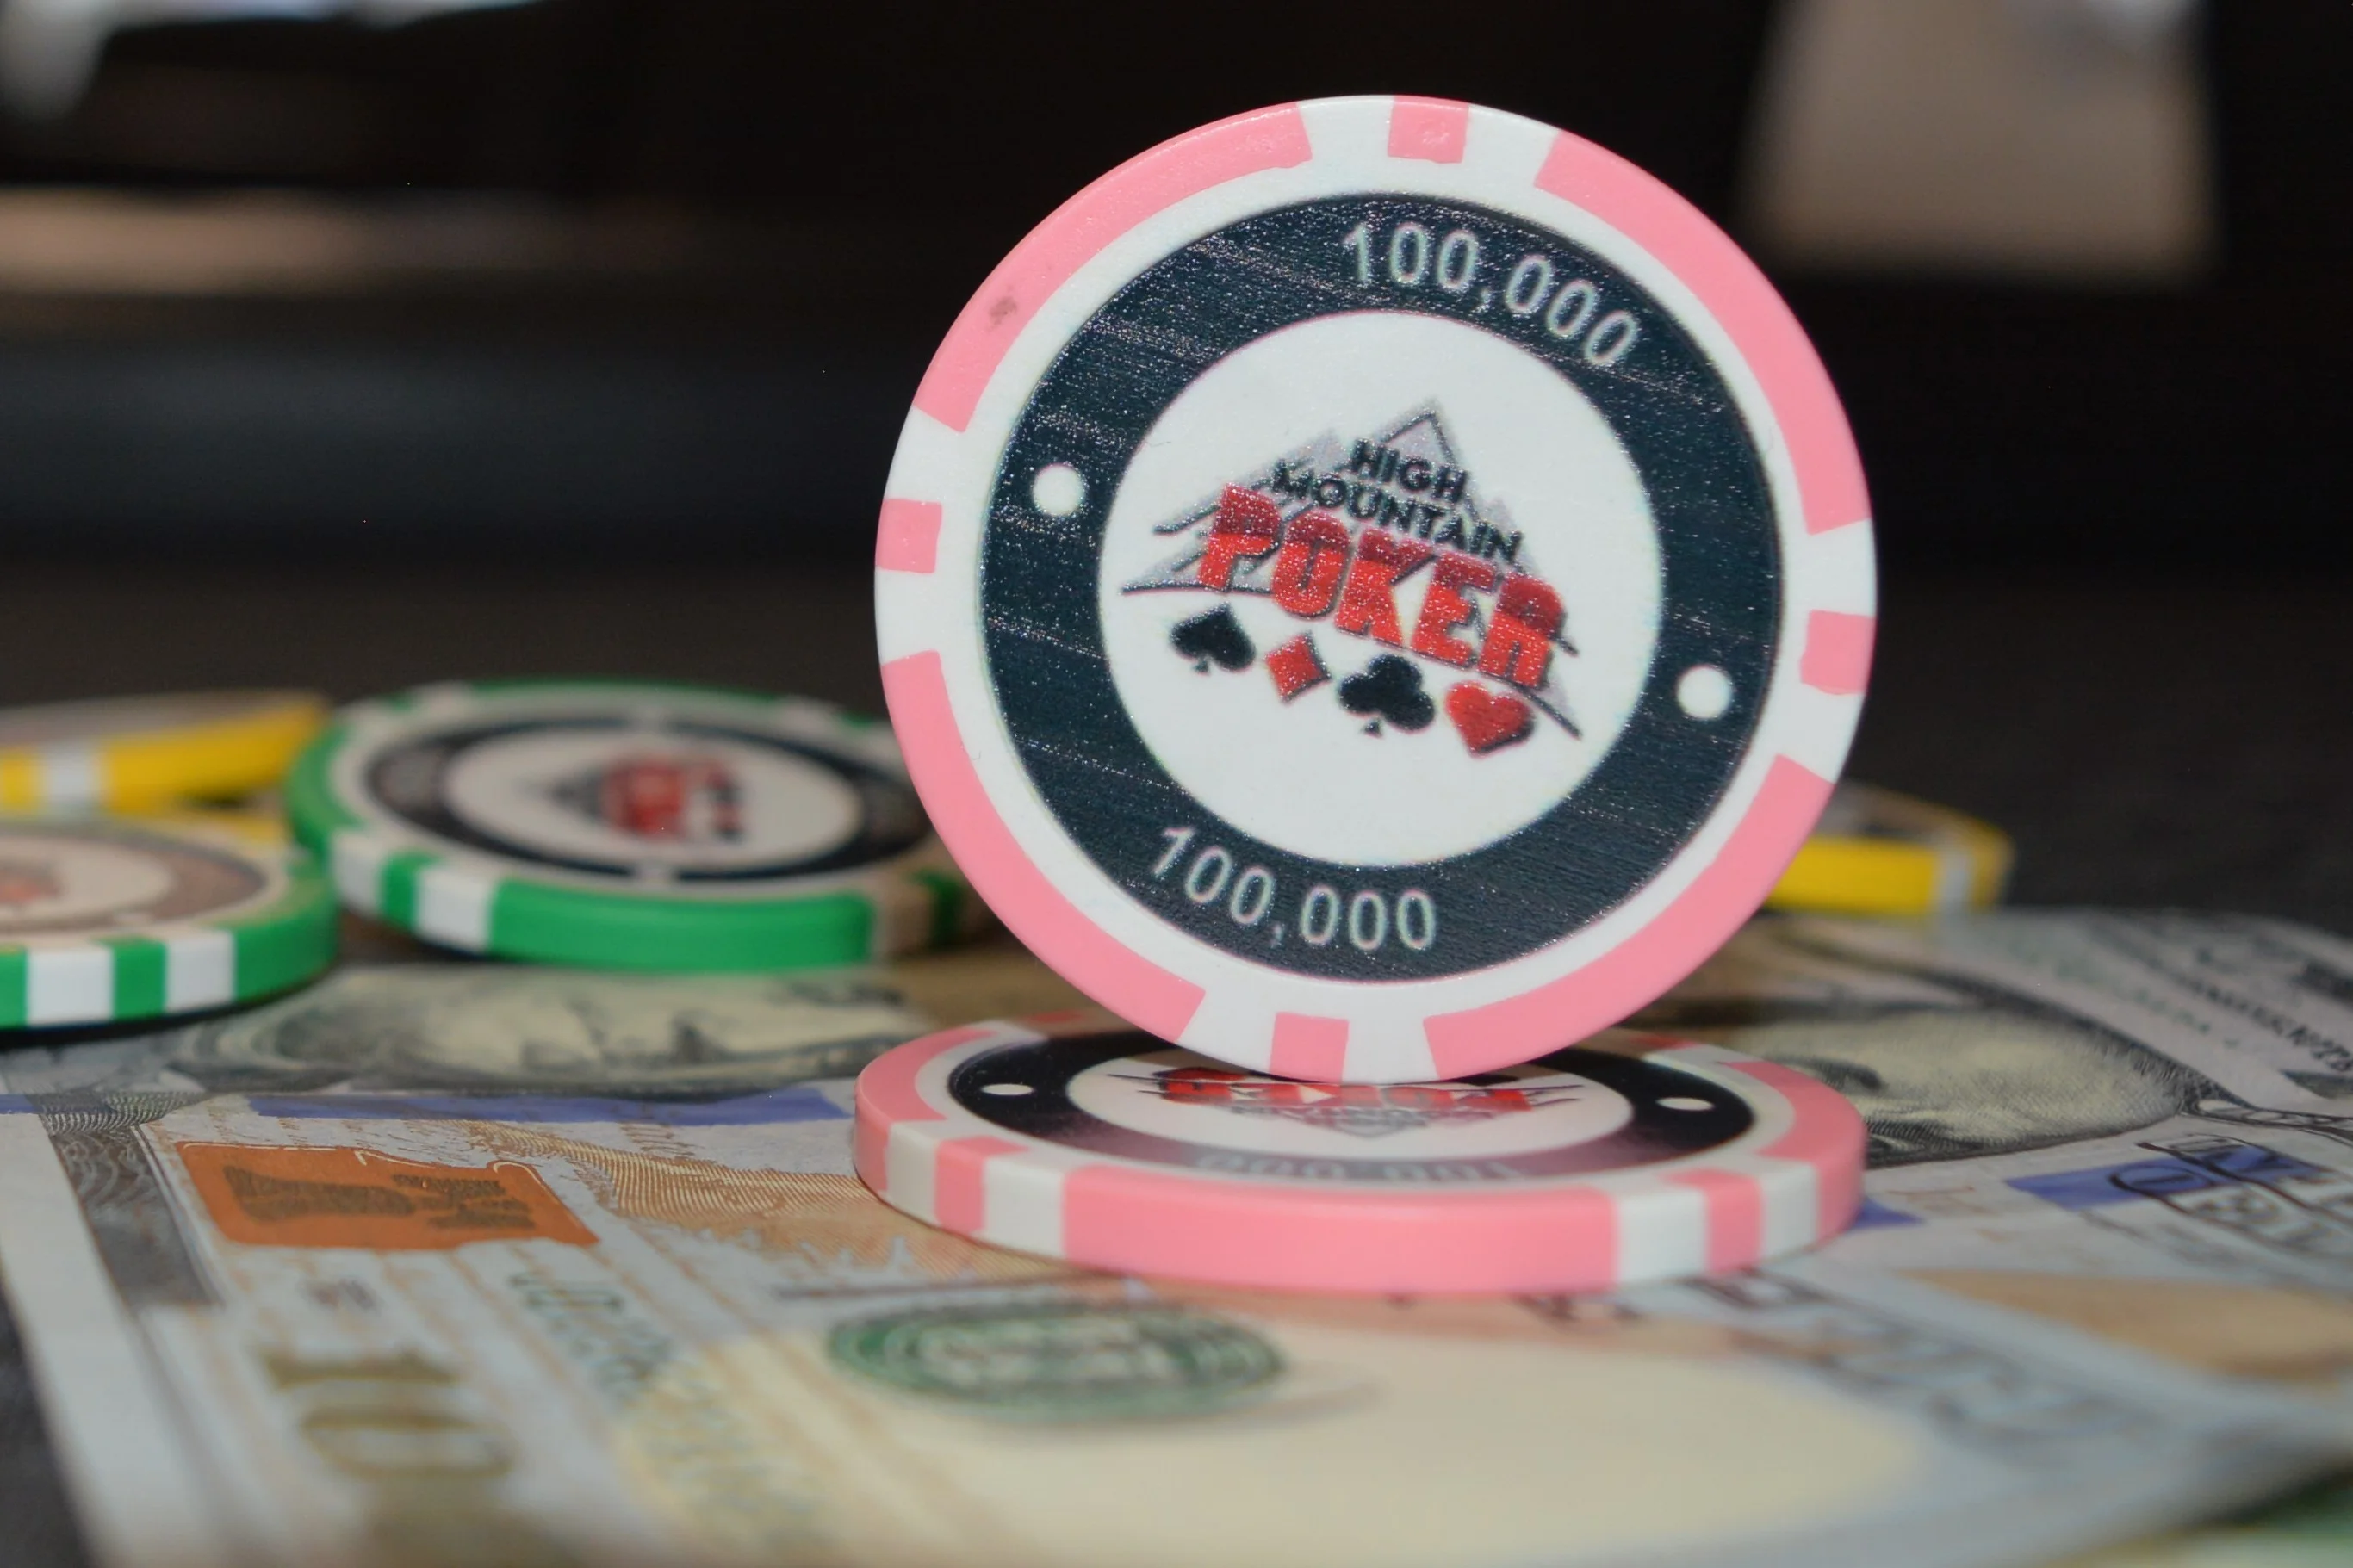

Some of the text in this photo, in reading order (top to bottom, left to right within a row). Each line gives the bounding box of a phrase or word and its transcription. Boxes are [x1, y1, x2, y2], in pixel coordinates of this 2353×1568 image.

[1342, 220, 1640, 368] 100,000
[1270, 458, 1524, 564] MOUNTAIN
[1349, 437, 1468, 503] HIGH
[1197, 482, 1569, 689] POKER
[1152, 827, 1437, 951] 100,000
